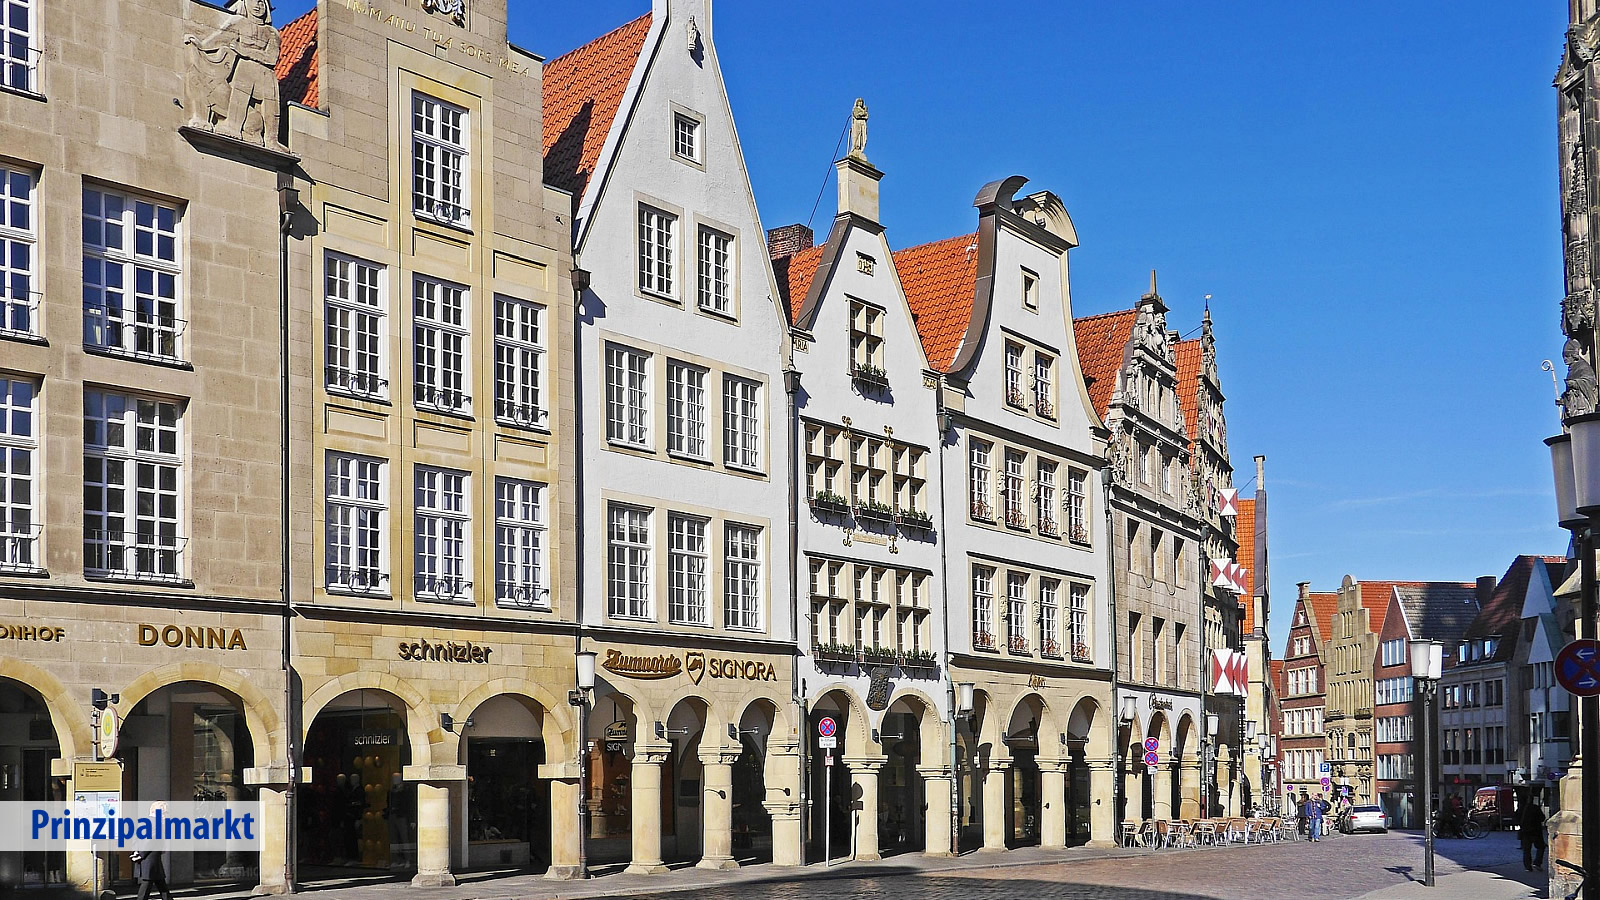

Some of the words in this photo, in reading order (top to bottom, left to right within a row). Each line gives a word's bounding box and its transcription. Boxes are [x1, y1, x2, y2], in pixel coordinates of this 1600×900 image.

[423, 27, 453, 49] TUA
[459, 42, 492, 64] SORS
[498, 56, 530, 78] MEA
[137, 623, 248, 651] DONNA
[398, 637, 493, 664] schnitzler
[605, 648, 682, 673] Zumnorde
[708, 657, 778, 682] SIGNORA
[354, 732, 392, 746] schnitzler
